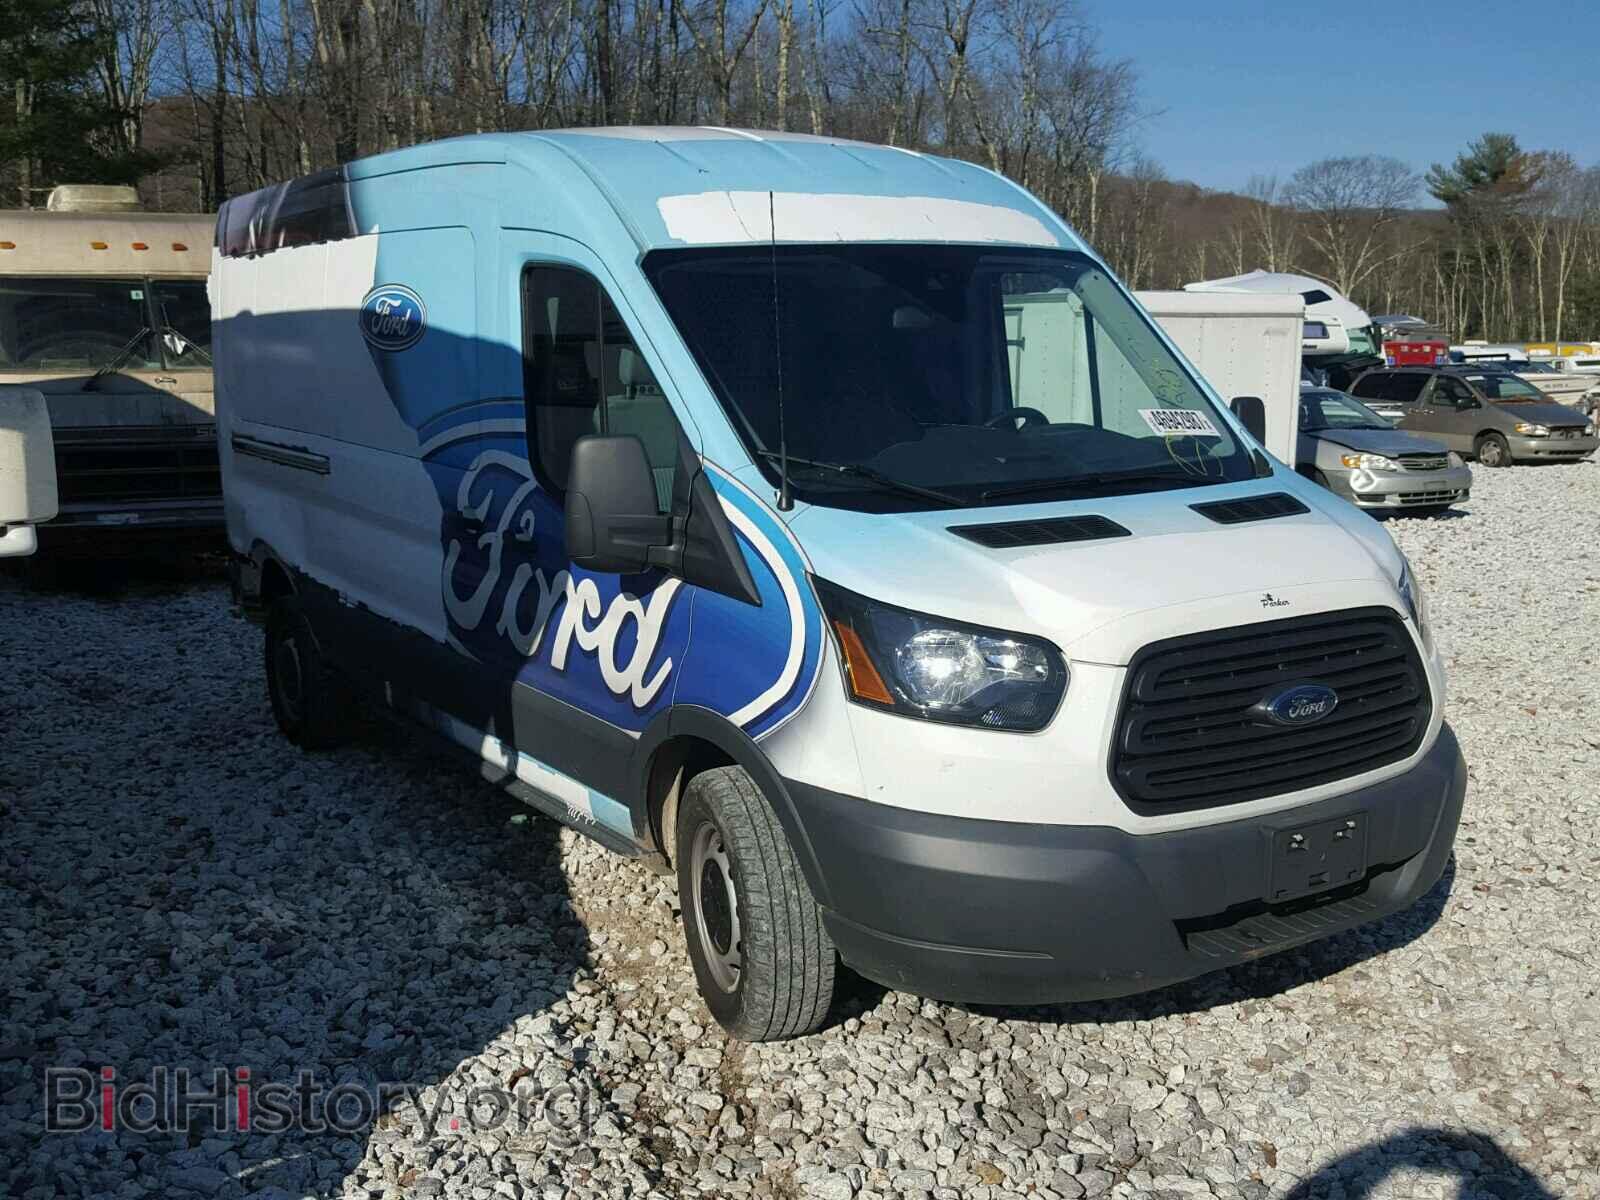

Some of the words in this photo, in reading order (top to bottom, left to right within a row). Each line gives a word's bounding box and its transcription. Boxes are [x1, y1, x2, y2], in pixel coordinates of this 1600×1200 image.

[371, 296, 412, 337] Ford
[1149, 410, 1203, 431] 46942987
[443, 449, 683, 708] Ford
[1288, 694, 1328, 718] Ford
